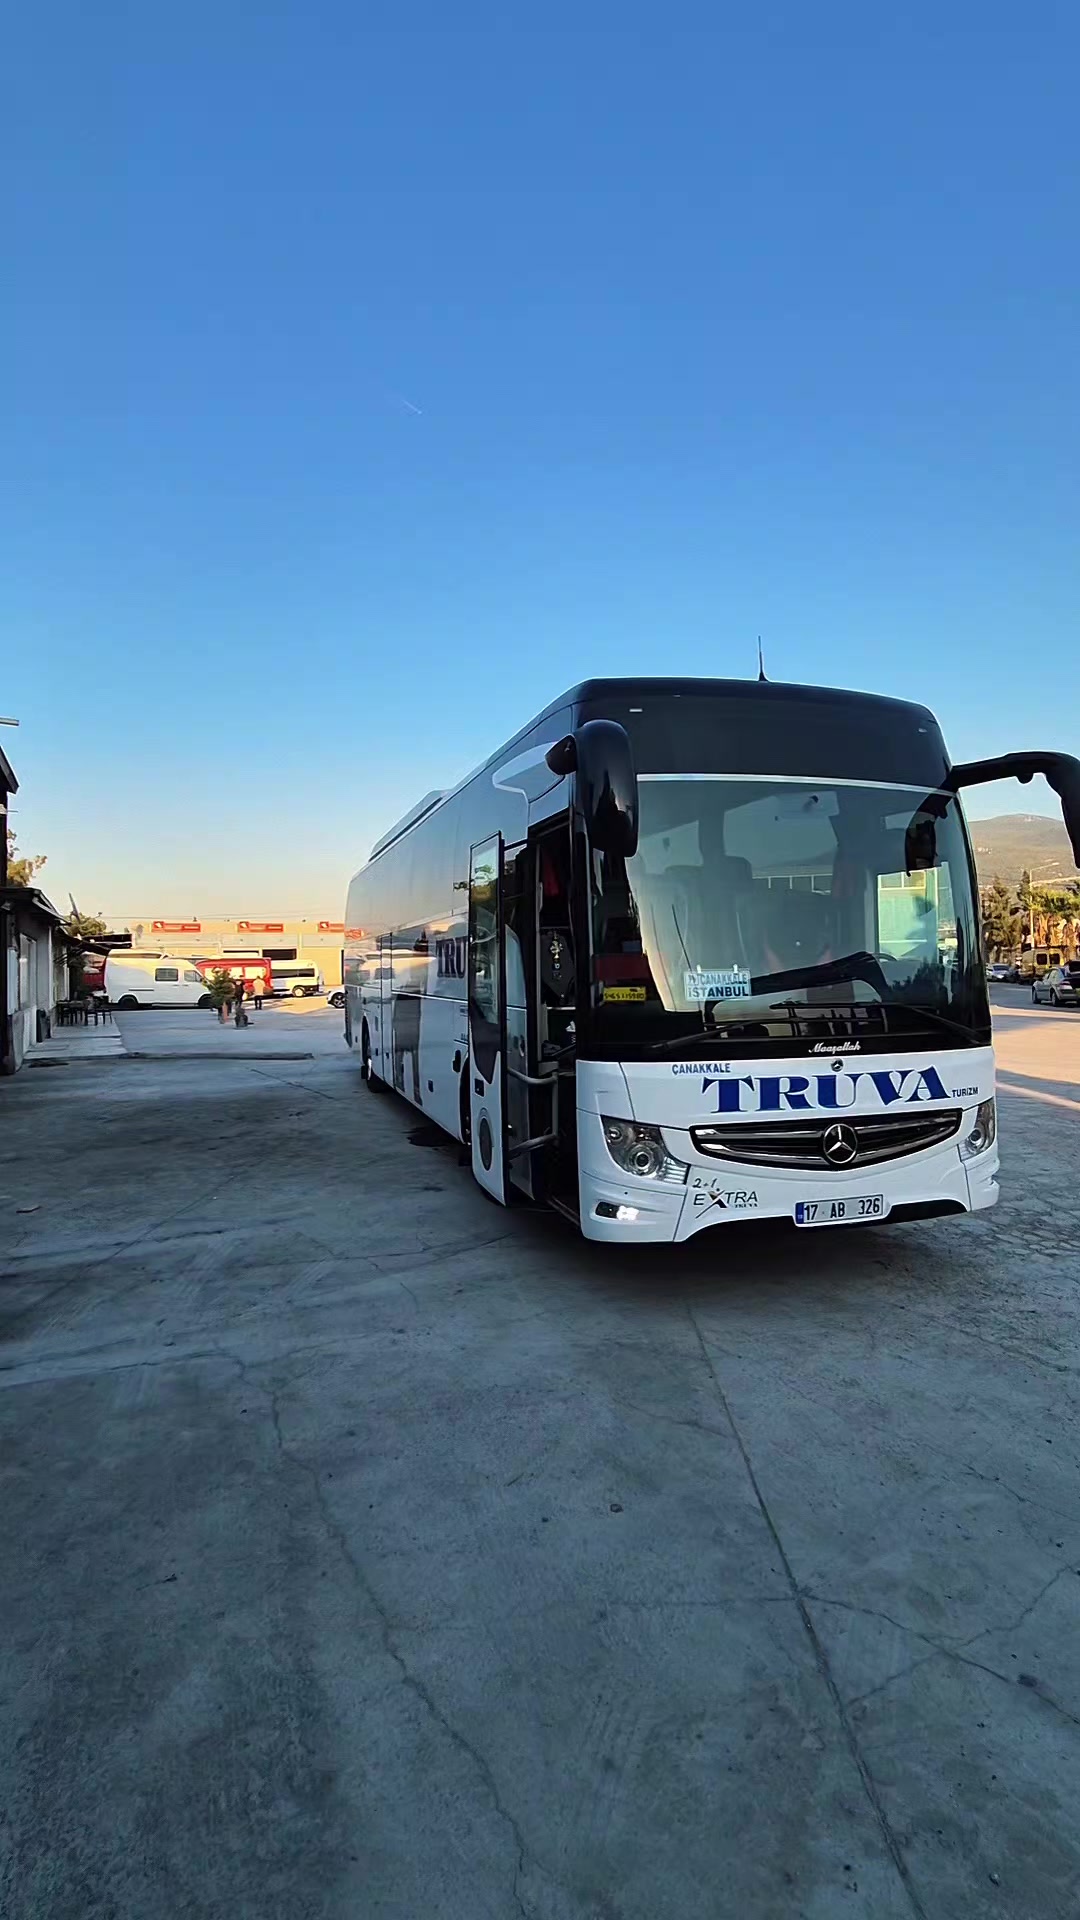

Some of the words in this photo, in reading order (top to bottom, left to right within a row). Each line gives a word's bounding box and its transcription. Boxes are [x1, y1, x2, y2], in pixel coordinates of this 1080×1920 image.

[672, 1063, 730, 1075] ÇANAKKALE
[702, 1066, 951, 1113] TRUVA
[804, 1204, 818, 1220] 17
[830, 1202, 845, 1218] AB
[858, 1198, 880, 1215] 326
